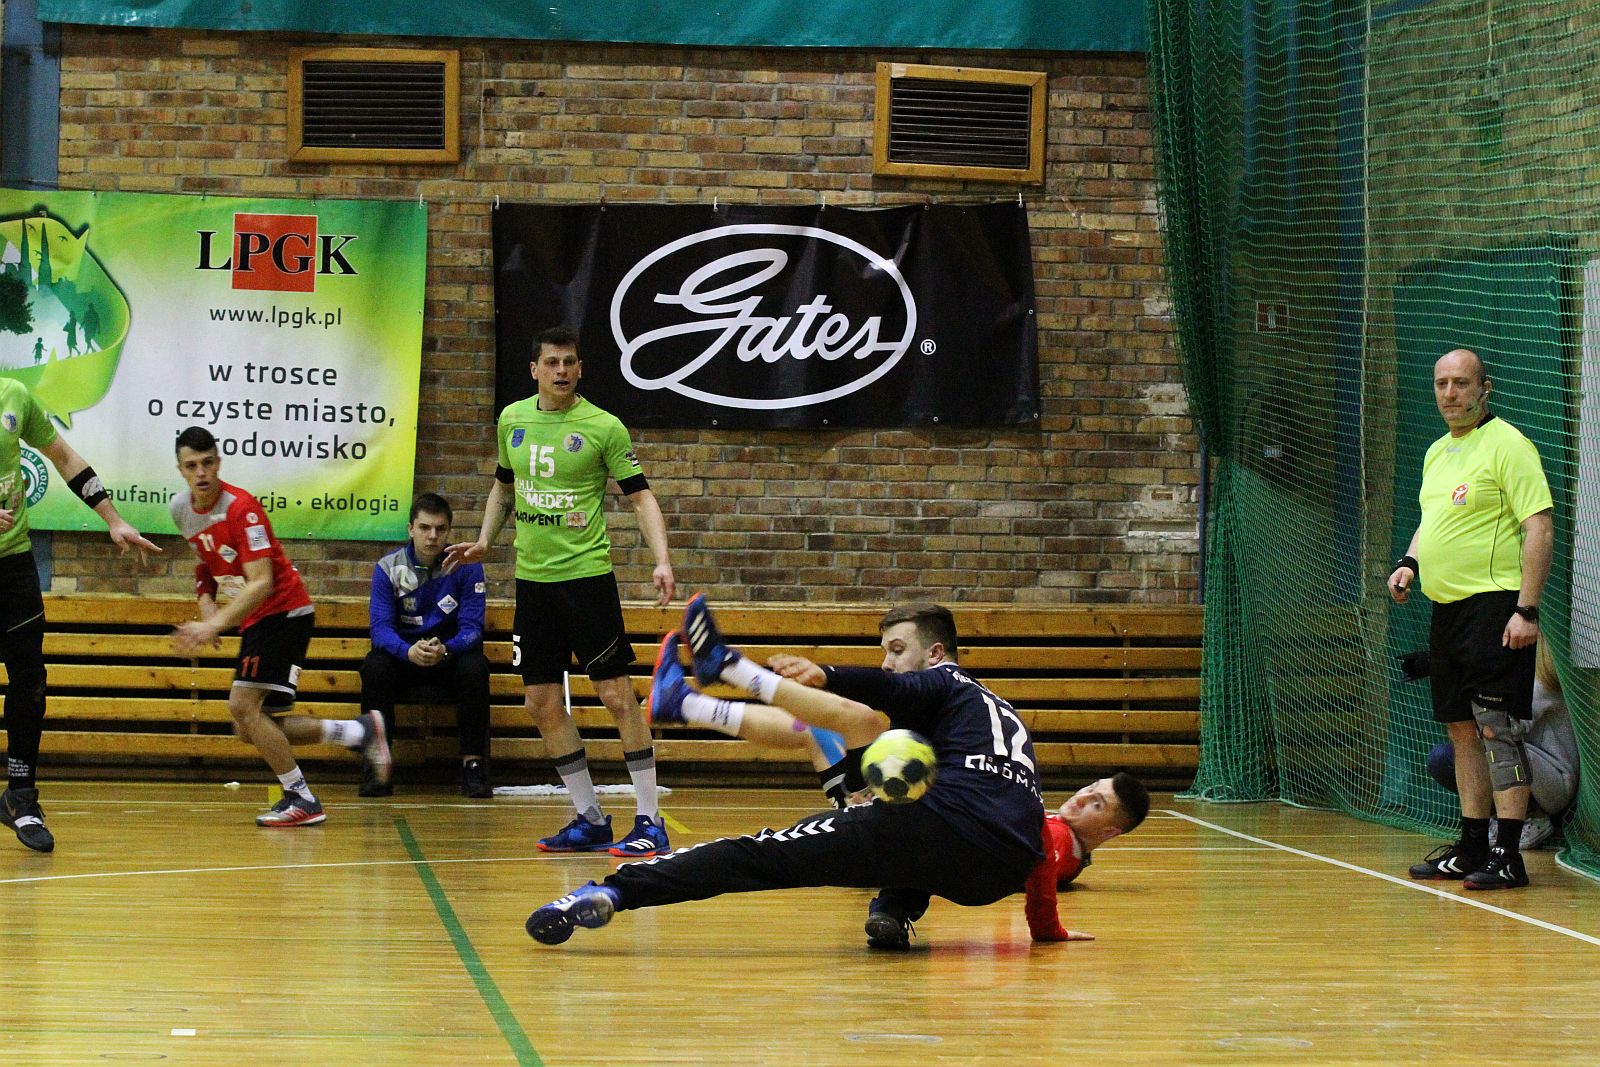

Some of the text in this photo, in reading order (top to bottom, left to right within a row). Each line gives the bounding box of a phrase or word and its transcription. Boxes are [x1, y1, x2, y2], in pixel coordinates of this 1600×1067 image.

[195, 230, 359, 275] LPGK
[209, 305, 341, 329] www.lpgk.pl
[620, 247, 887, 390] Gates
[209, 362, 338, 386] w trosce
[148, 398, 395, 427] o czyste miasto,
[529, 444, 555, 478] 15
[311, 492, 399, 516] ekologia
[198, 533, 216, 552] 11
[241, 655, 260, 677] 11
[981, 692, 1035, 774] 12
